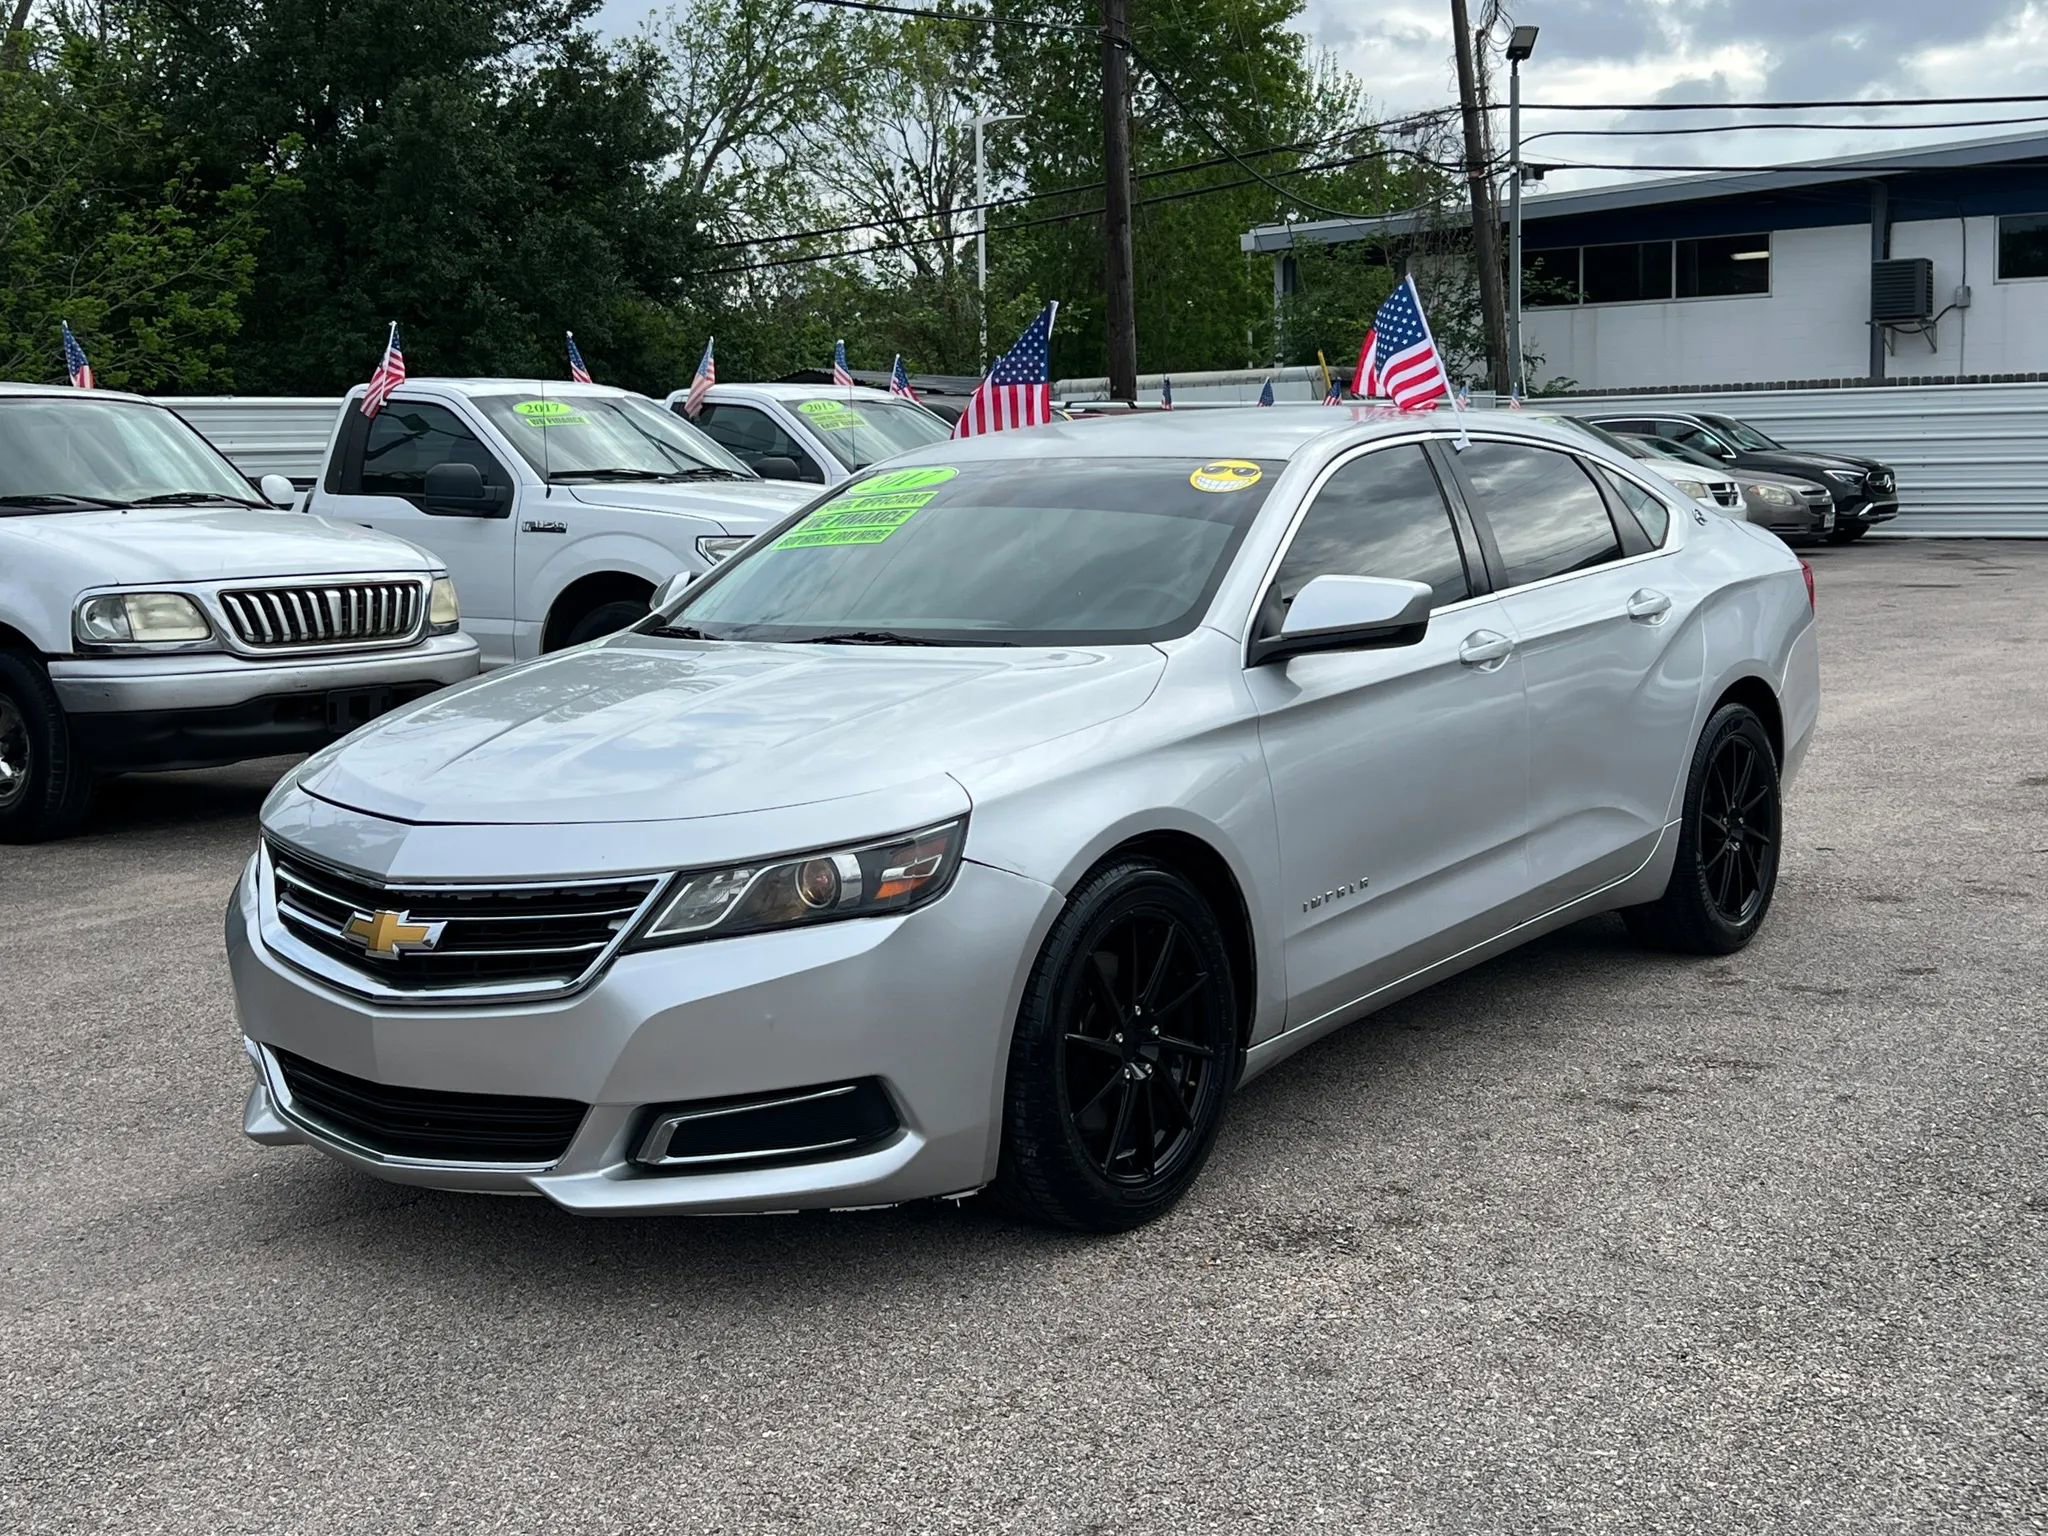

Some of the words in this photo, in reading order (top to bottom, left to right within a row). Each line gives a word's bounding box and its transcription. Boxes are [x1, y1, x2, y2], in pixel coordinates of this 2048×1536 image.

[525, 403, 560, 414] 2017
[853, 492, 936, 508] EFFICIENT
[825, 509, 909, 527] FINANCE
[1303, 876, 1369, 913] IMPALA
